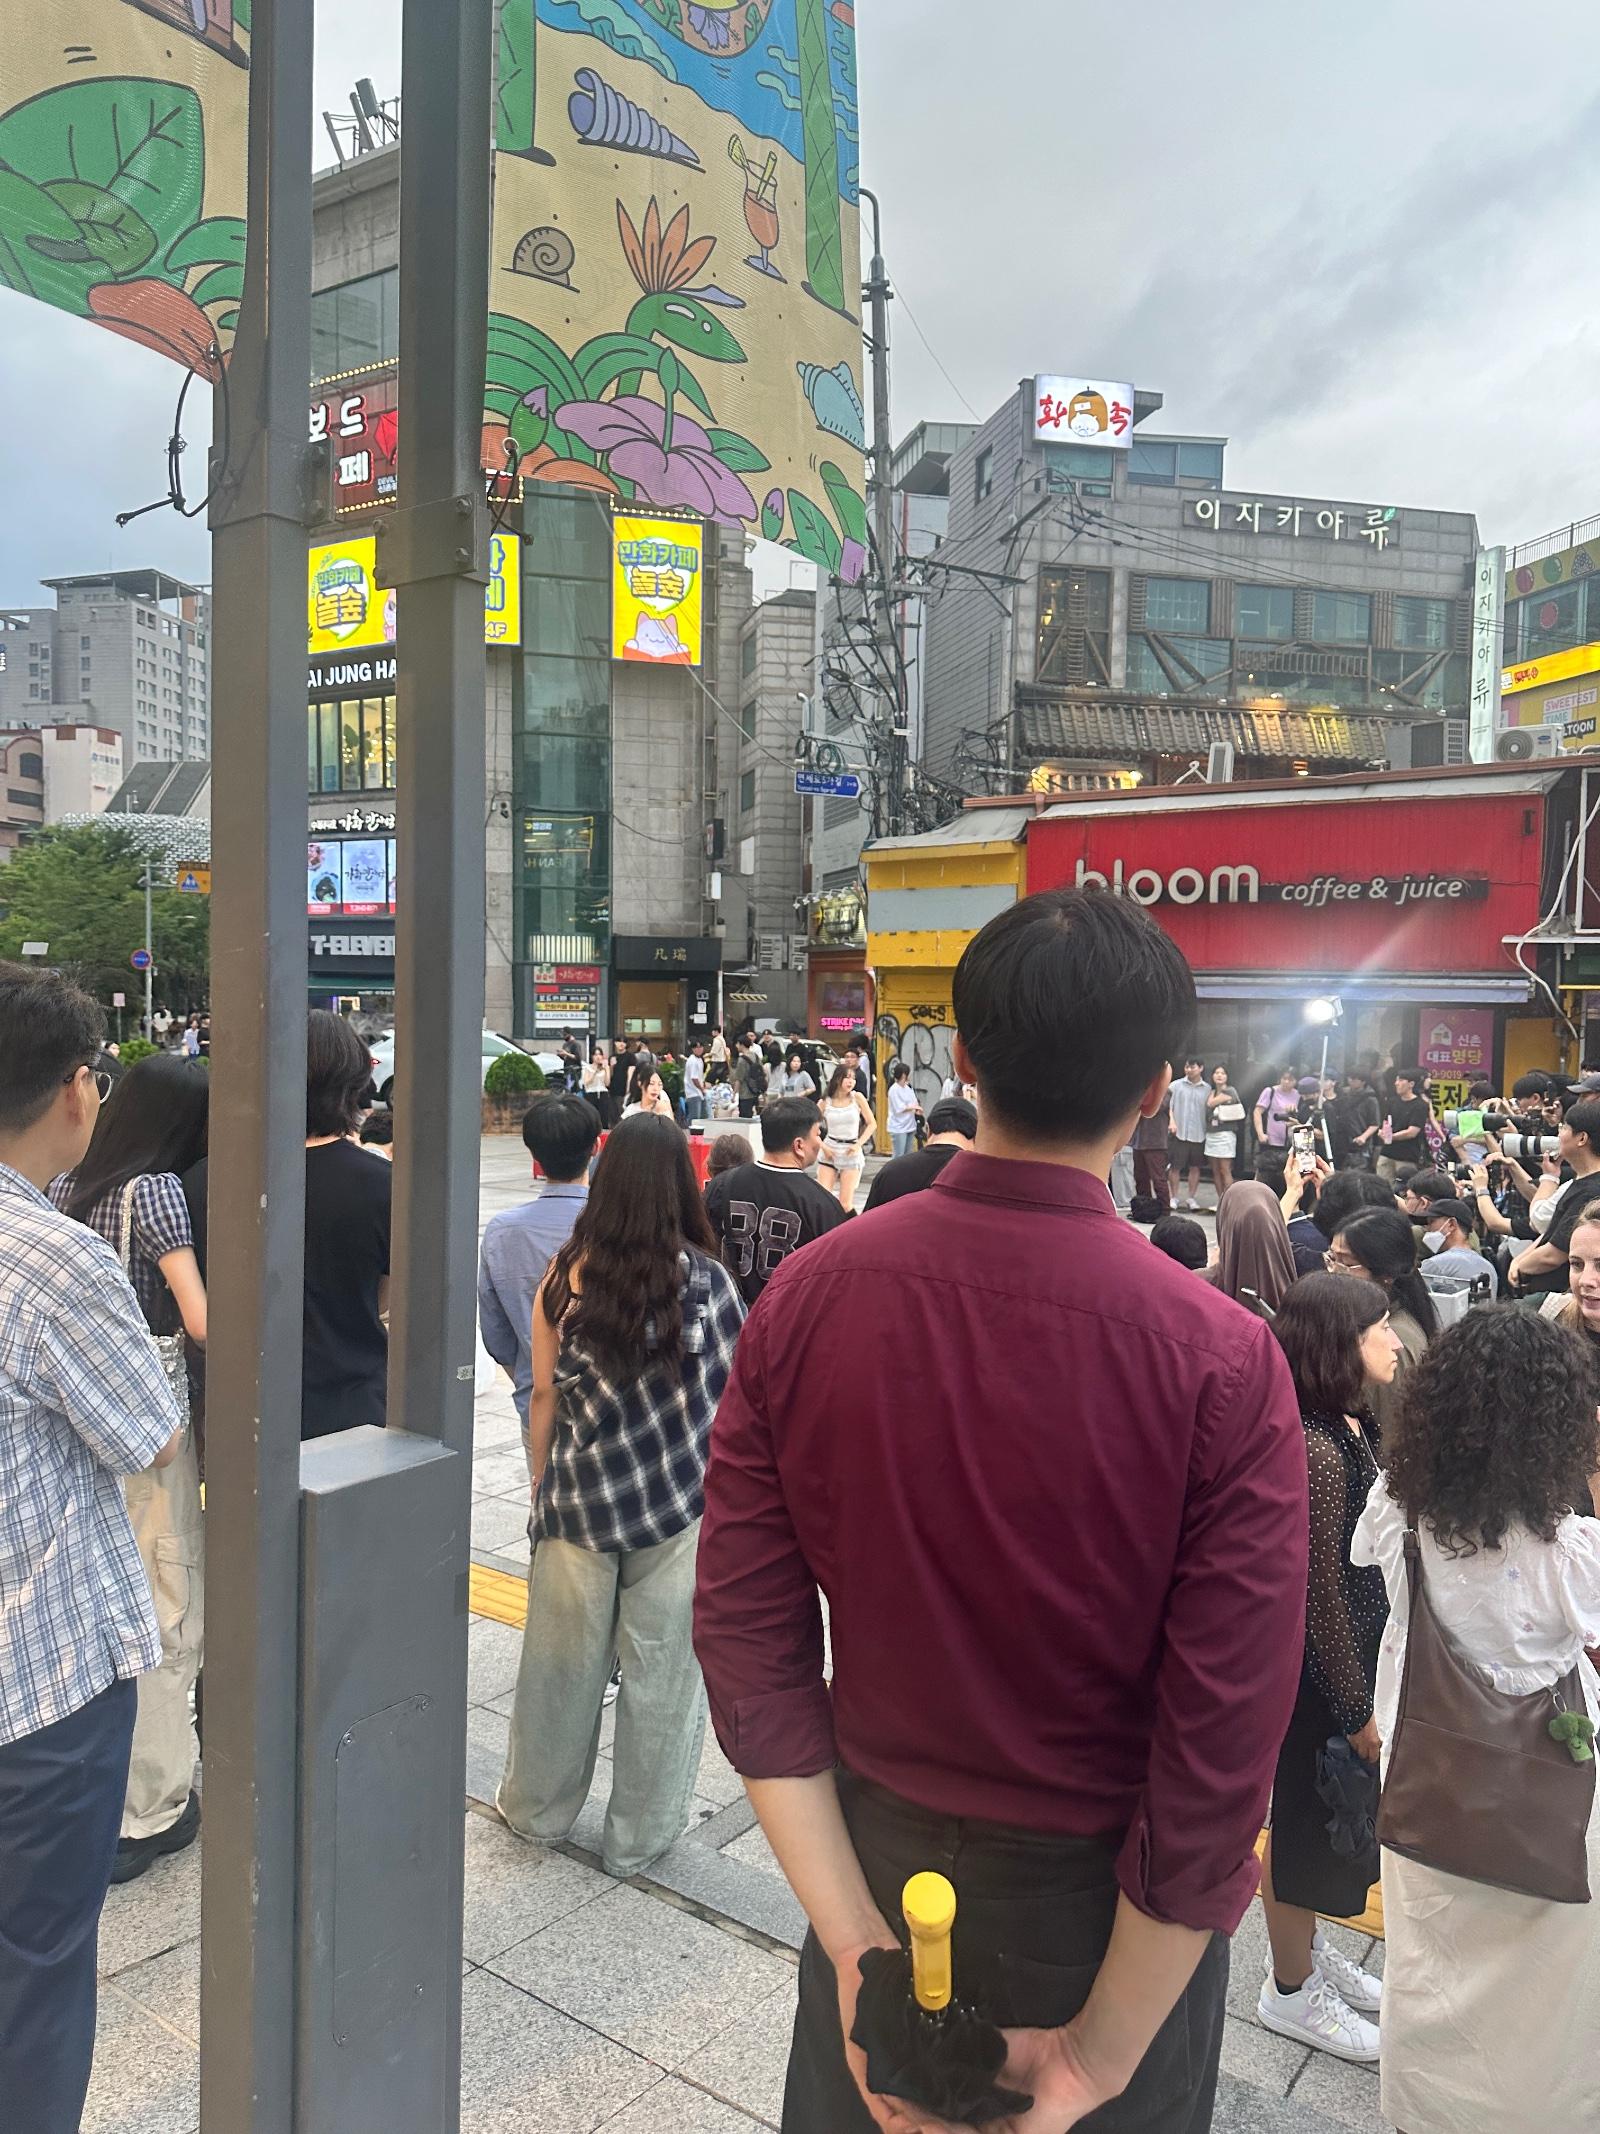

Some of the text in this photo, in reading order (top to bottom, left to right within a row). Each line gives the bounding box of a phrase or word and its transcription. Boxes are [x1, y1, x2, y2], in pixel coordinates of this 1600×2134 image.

[618, 540, 697, 573] 만화카페
[630, 566, 685, 601] 놀숲
[316, 584, 367, 630] 놀숲
[325, 662, 372, 686] JUNG
[1545, 690, 1595, 712] SWEETEST
[1545, 710, 1569, 724] TIME
[1076, 858, 1463, 907] bloom coffee & juice
